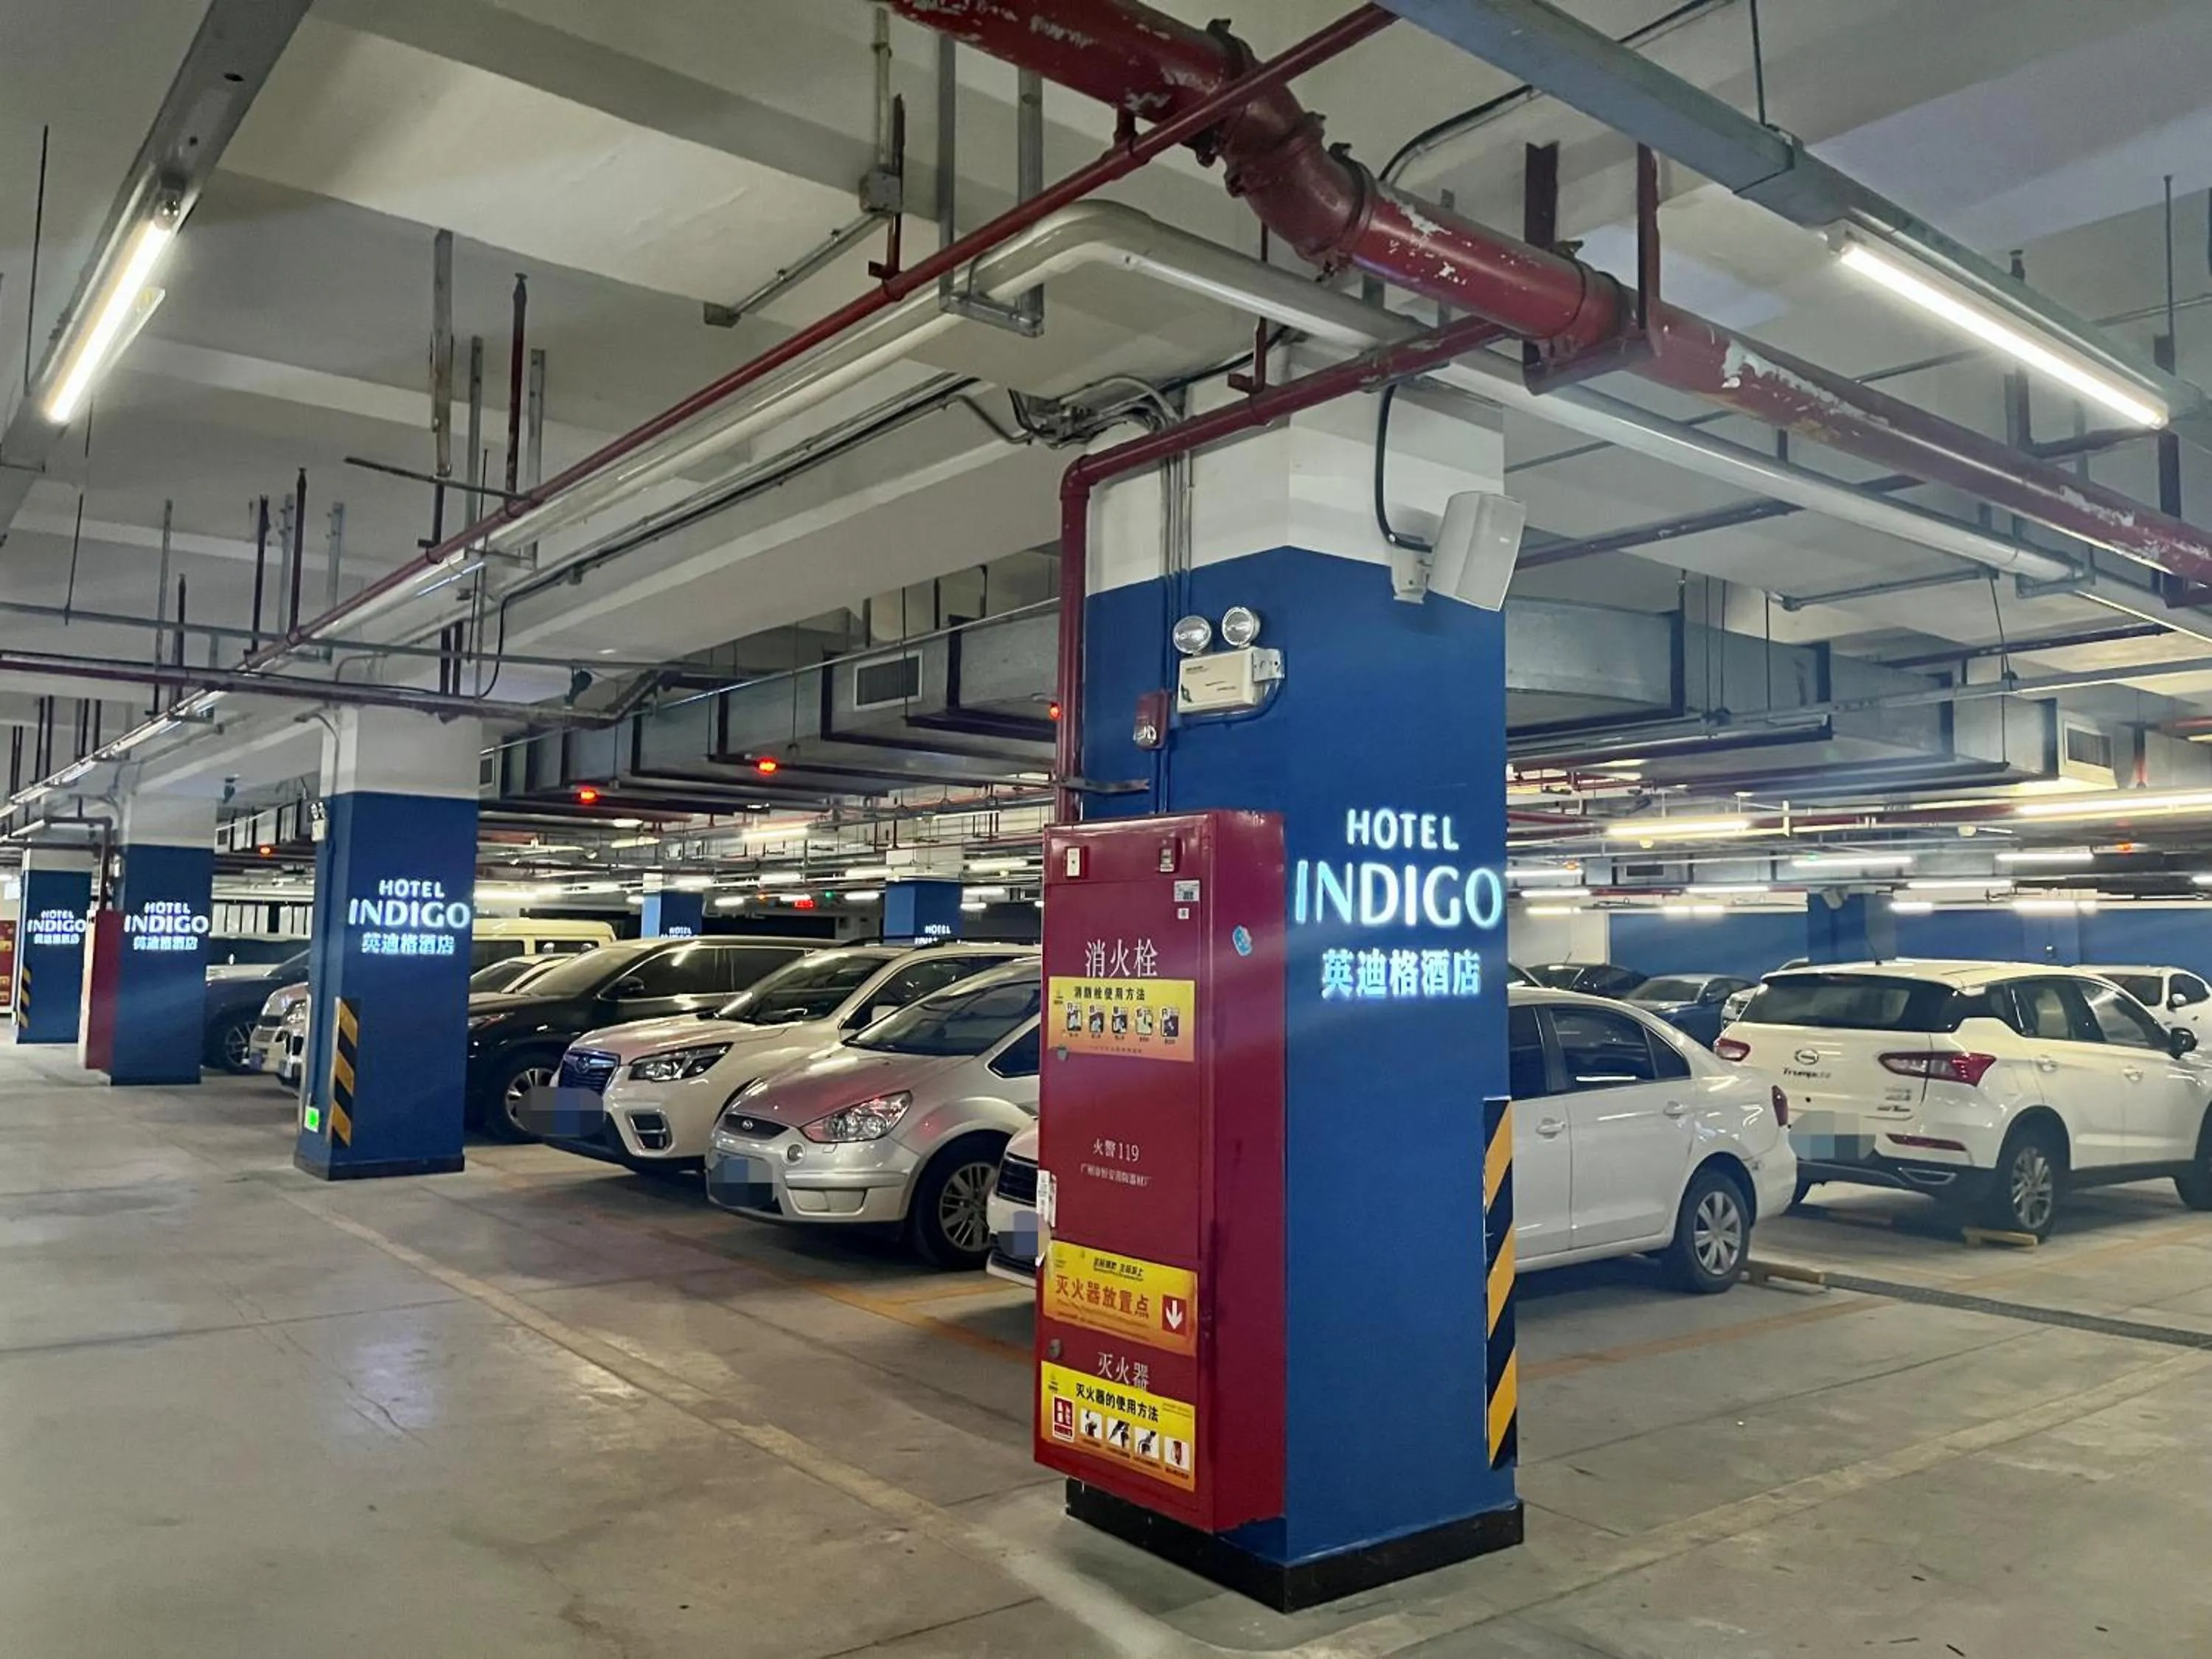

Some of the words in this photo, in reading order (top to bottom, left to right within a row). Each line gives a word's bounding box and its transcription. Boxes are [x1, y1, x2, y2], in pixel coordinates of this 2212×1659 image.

[1347, 808, 1459, 850] HOTEL
[379, 878, 445, 898] HOTEL
[1295, 860, 1502, 929] INDIGO
[41, 909, 74, 919] HOTEL
[144, 901, 191, 914] HOTEL
[348, 898, 470, 928] INDIGO
[27, 919, 86, 933] INDIGO
[124, 914, 209, 933] INDIGO
[361, 932, 455, 955] 英迪格酒店
[1085, 938, 1158, 978] 消火栓
[1322, 948, 1481, 998] 英迪格酒店
[1093, 1138, 1139, 1162] 火警119
[1056, 1274, 1150, 1319] 灭火器放置点
[1097, 1352, 1150, 1391] 灭火器
[1076, 1382, 1159, 1422] 灭火器的使用方法
